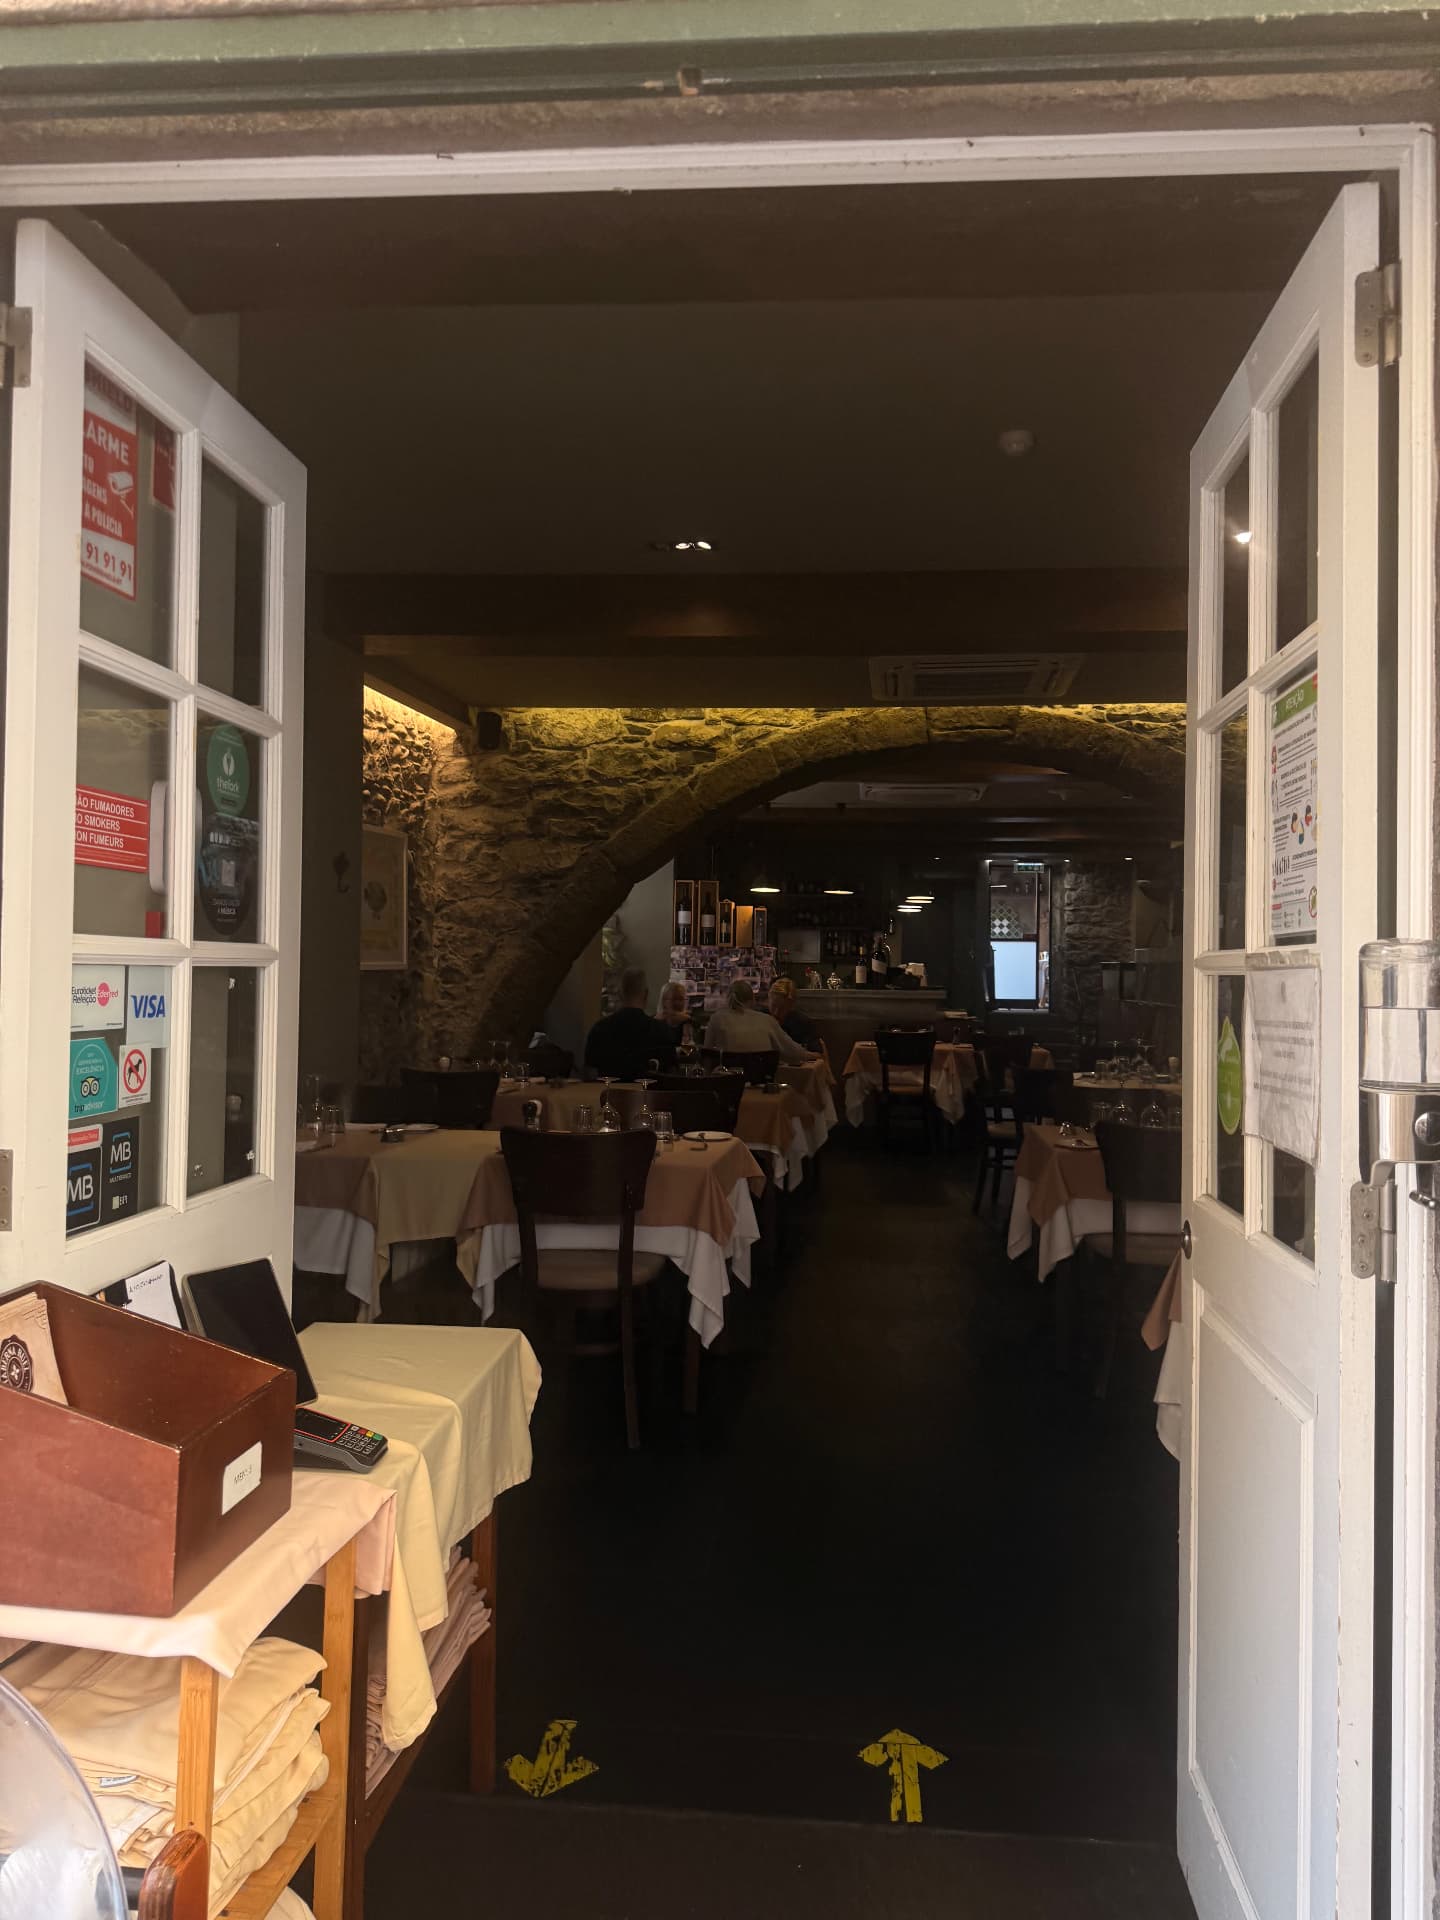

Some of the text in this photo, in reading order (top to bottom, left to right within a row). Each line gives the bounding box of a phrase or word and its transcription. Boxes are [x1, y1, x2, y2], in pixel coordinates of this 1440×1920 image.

[84, 420, 129, 466] ARME
[86, 542, 99, 564] 91
[104, 552, 116, 573] 91
[77, 793, 135, 818] ÃO FUMADORES
[84, 814, 121, 832] SMOKERS
[76, 831, 124, 849] ON FUMEURS
[131, 994, 166, 1019] VISA
[110, 1141, 132, 1164] MB
[67, 1174, 94, 1203] MB
